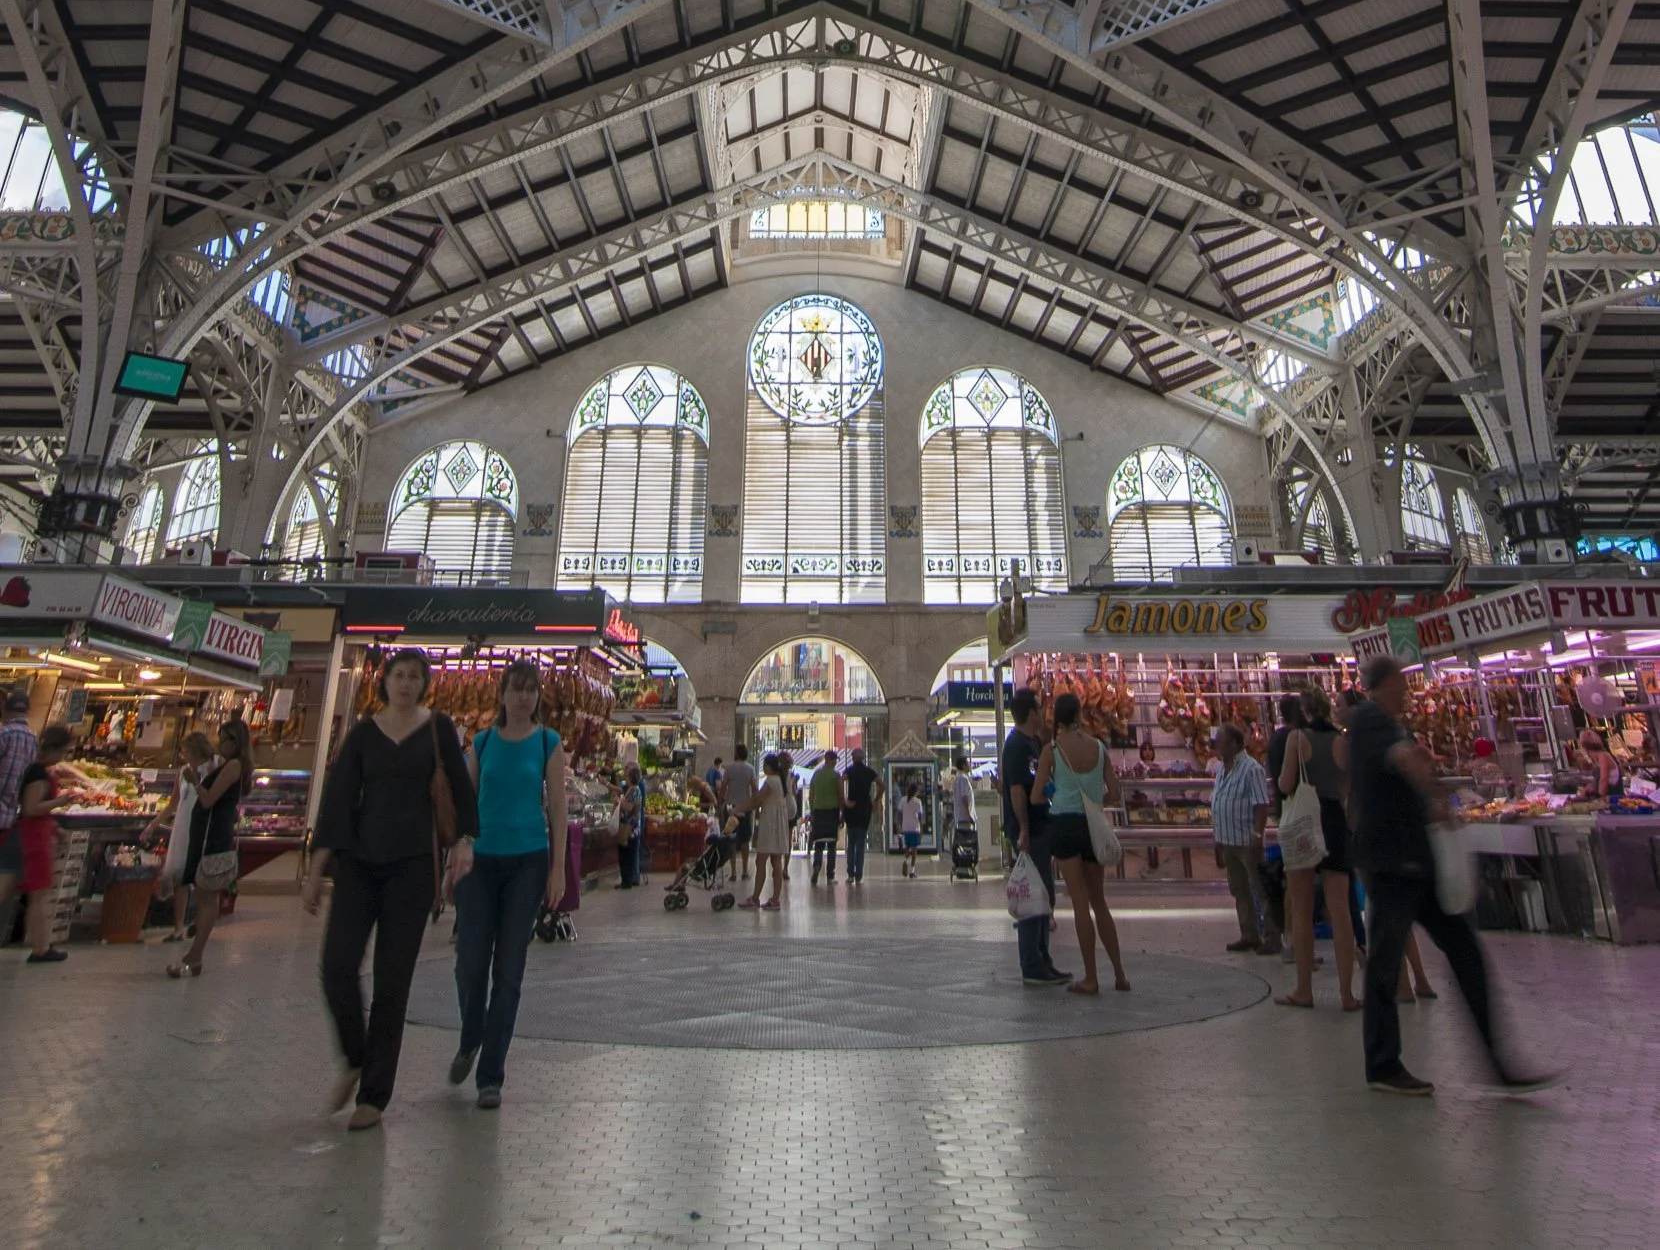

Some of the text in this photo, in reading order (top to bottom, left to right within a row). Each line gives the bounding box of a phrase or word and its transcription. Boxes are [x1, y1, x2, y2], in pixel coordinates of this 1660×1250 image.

[101, 582, 167, 631] VIRGINIA
[1084, 593, 1268, 635] Jamones
[1457, 588, 1546, 639] FRUTAS
[965, 686, 1009, 703] Horcha
